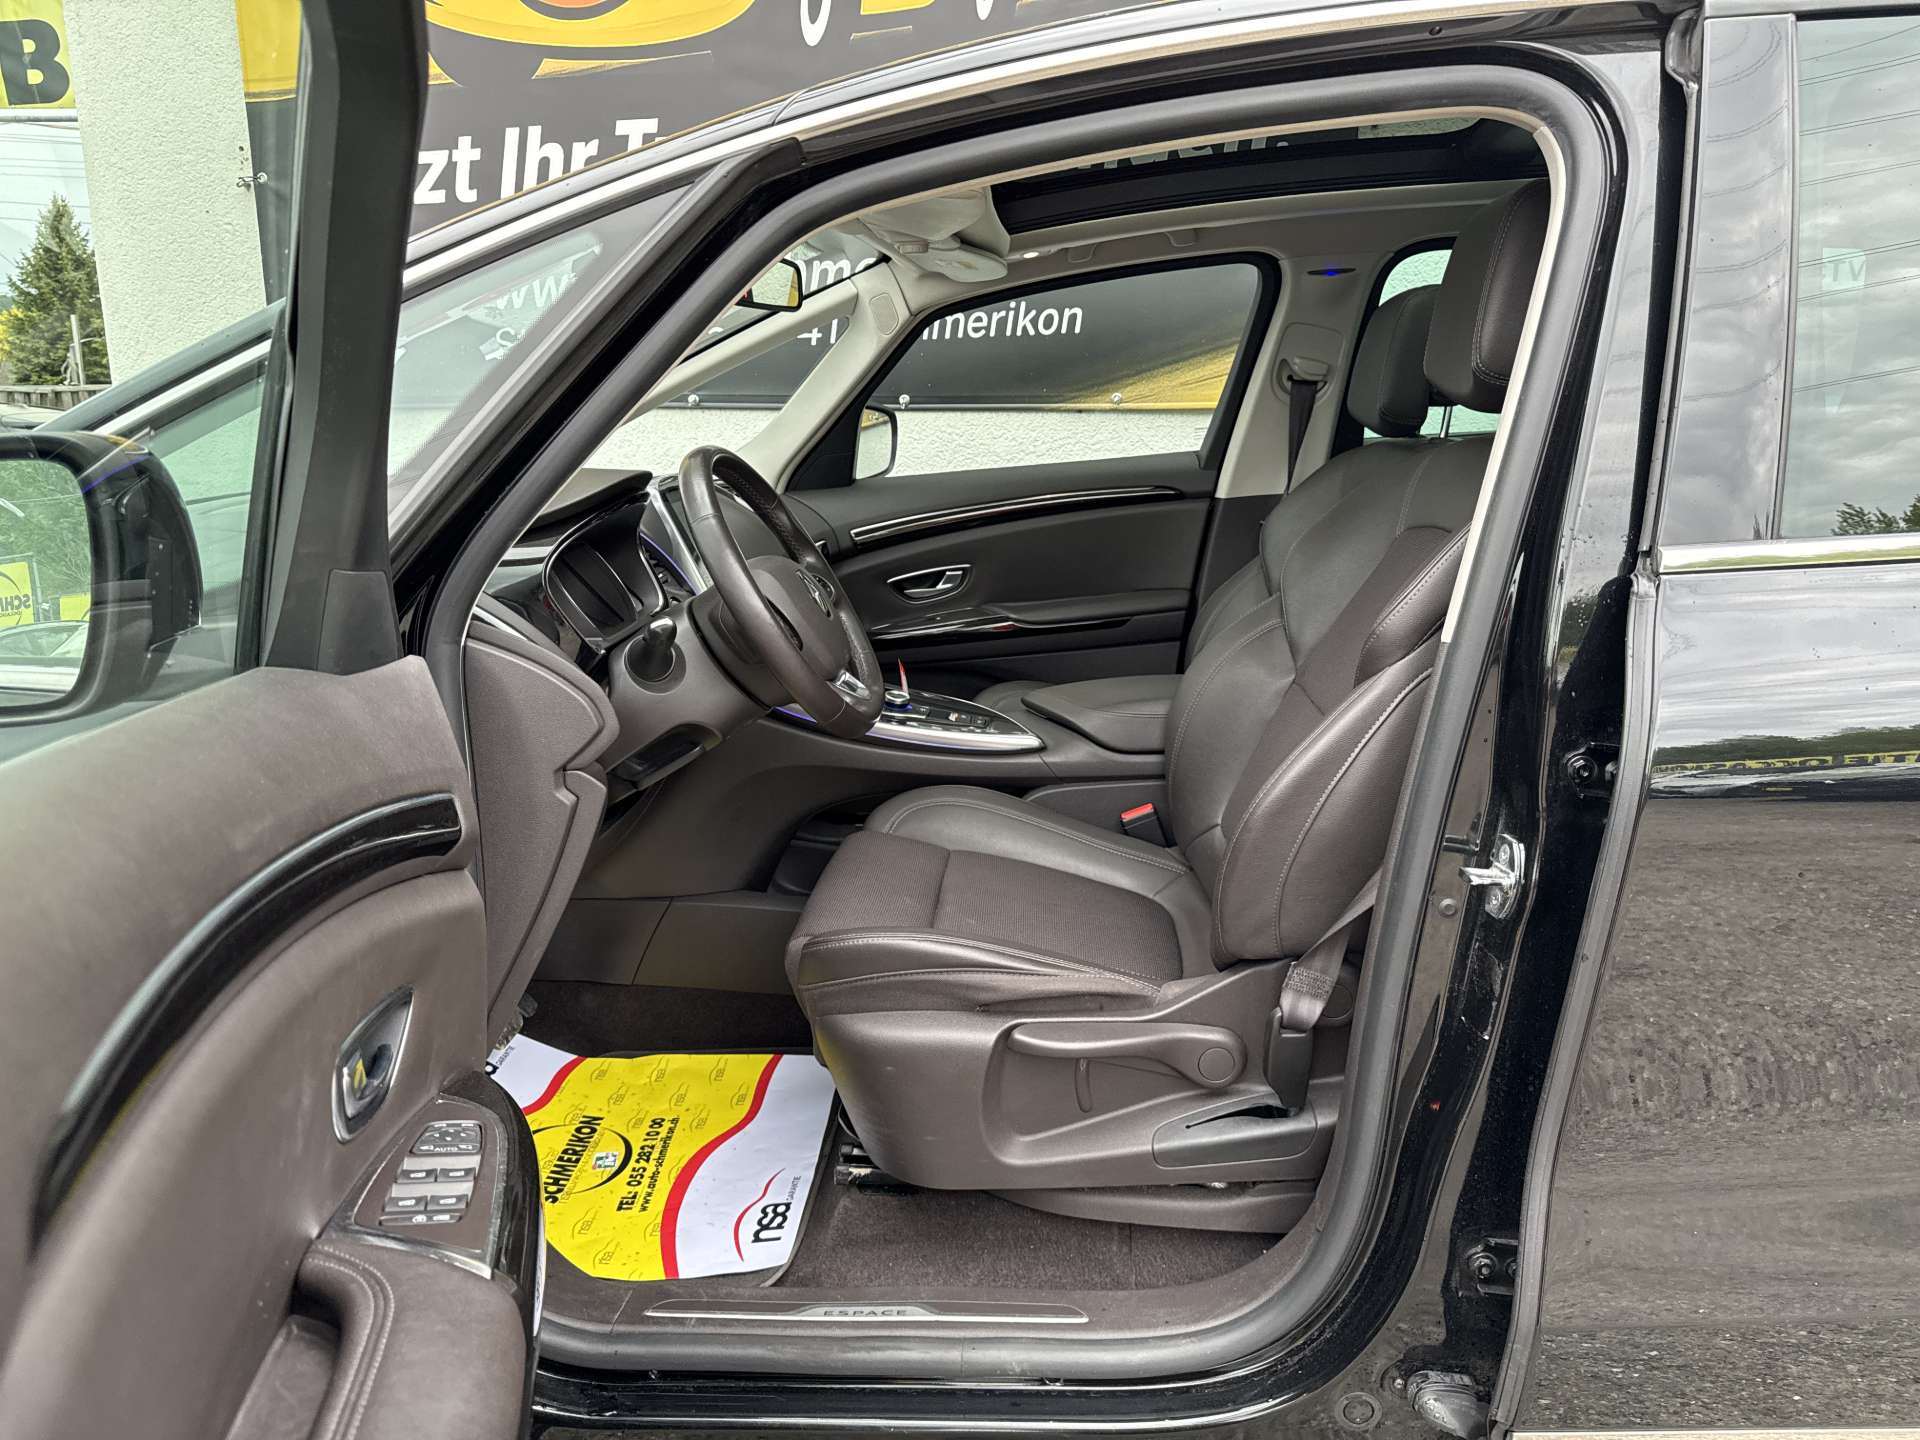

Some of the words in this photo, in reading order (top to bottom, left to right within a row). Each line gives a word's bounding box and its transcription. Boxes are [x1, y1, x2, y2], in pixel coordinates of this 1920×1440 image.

[501, 125, 600, 200] Ihr
[922, 301, 1083, 341] merikon
[649, 1117, 666, 1129] 00
[643, 1129, 660, 1142] 10
[635, 1143, 657, 1163] 282
[626, 1166, 648, 1187] 055
[751, 1201, 792, 1243] nsa
[823, 1309, 907, 1317] ESPACE
